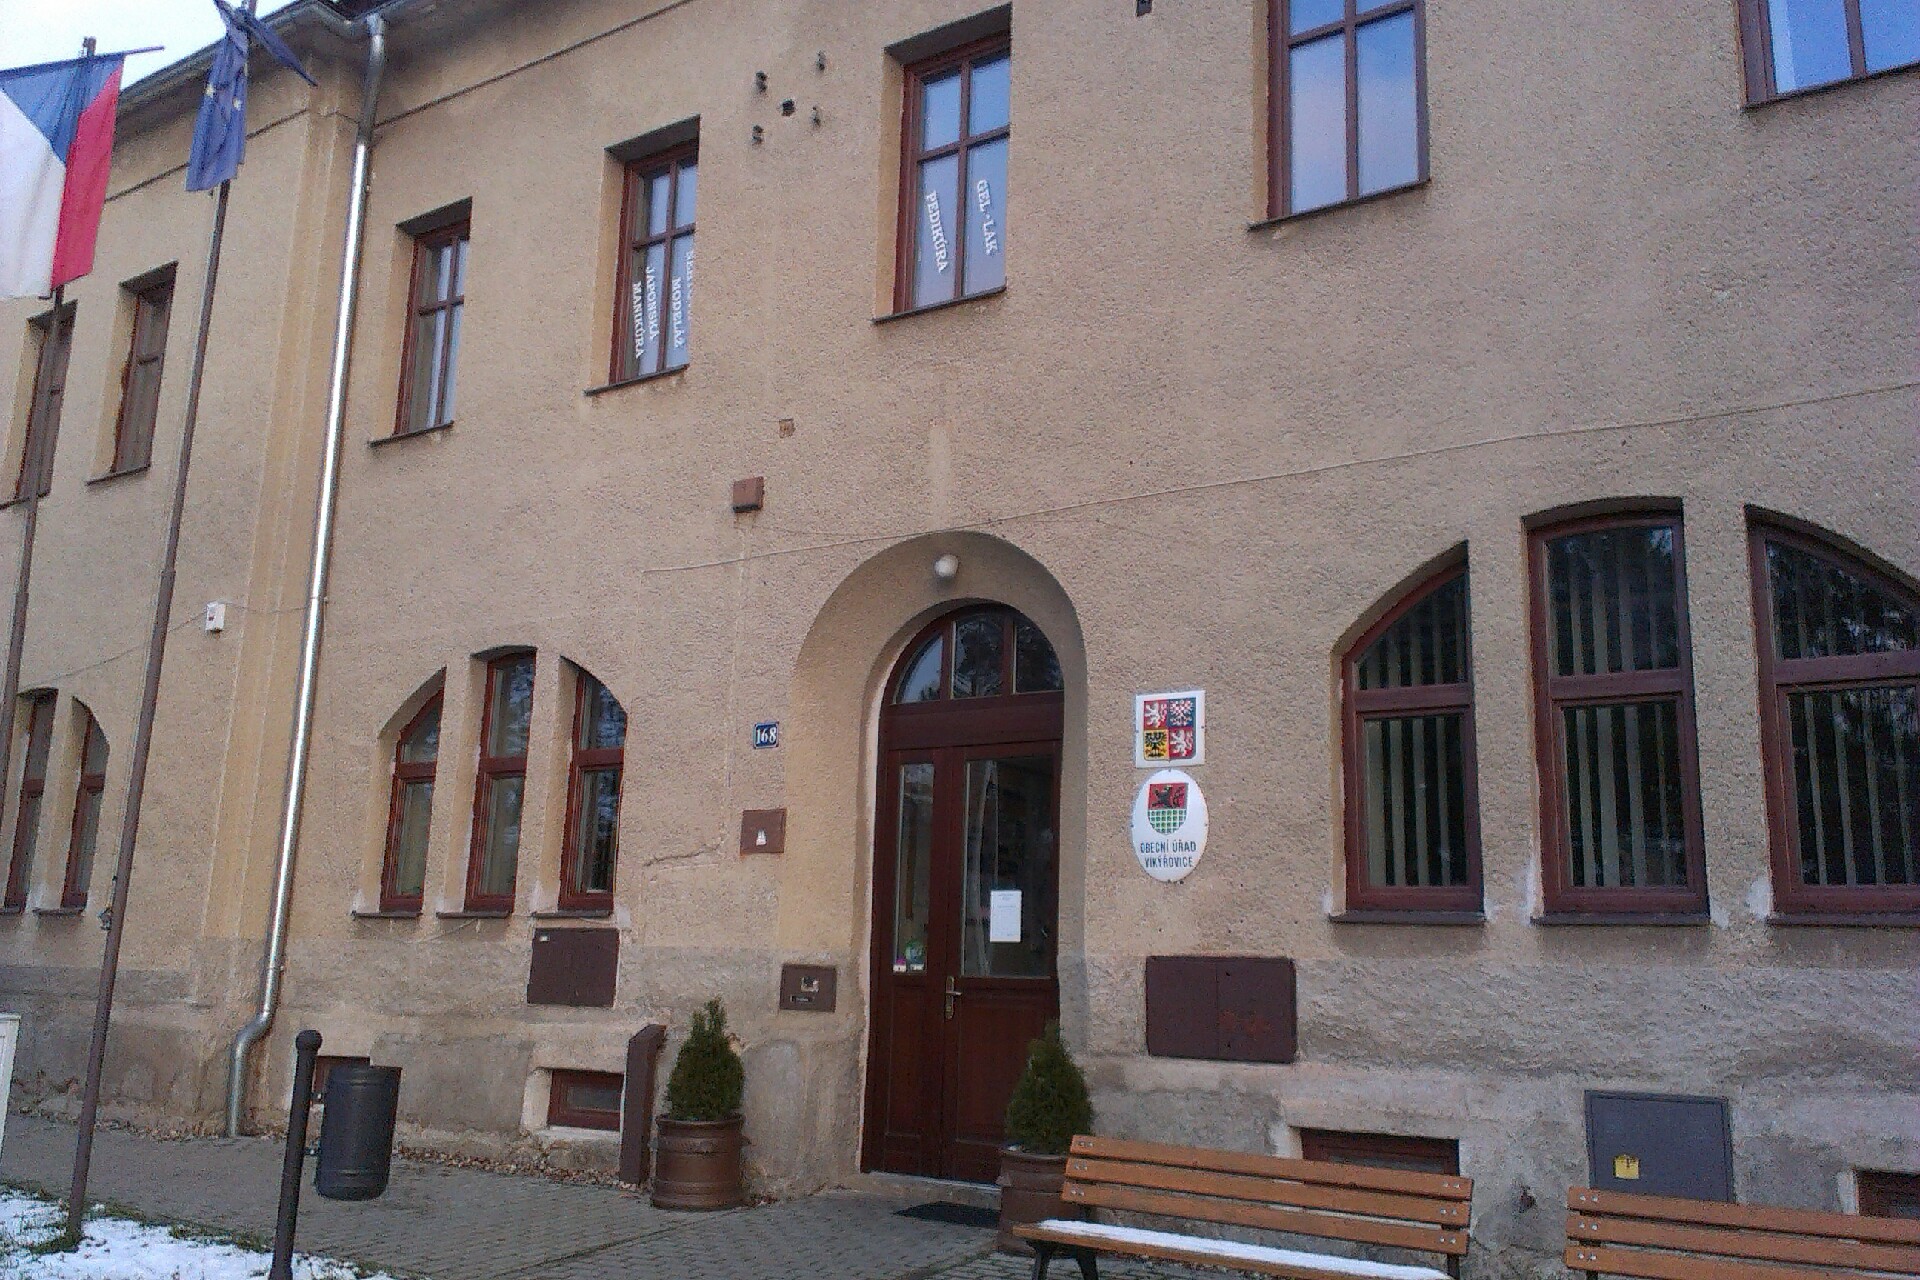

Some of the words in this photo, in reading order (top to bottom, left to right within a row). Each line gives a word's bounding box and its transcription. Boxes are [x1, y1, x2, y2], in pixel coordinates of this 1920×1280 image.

[926, 190, 948, 273] PEDIKÚRA
[633, 281, 645, 359] MANIKÚRA
[757, 727, 776, 744] 168
[1140, 840, 1169, 854] OBECNÍ
[1172, 839, 1196, 853] ÚŘAD
[1145, 854, 1193, 868] VIKÝŘOVICE
